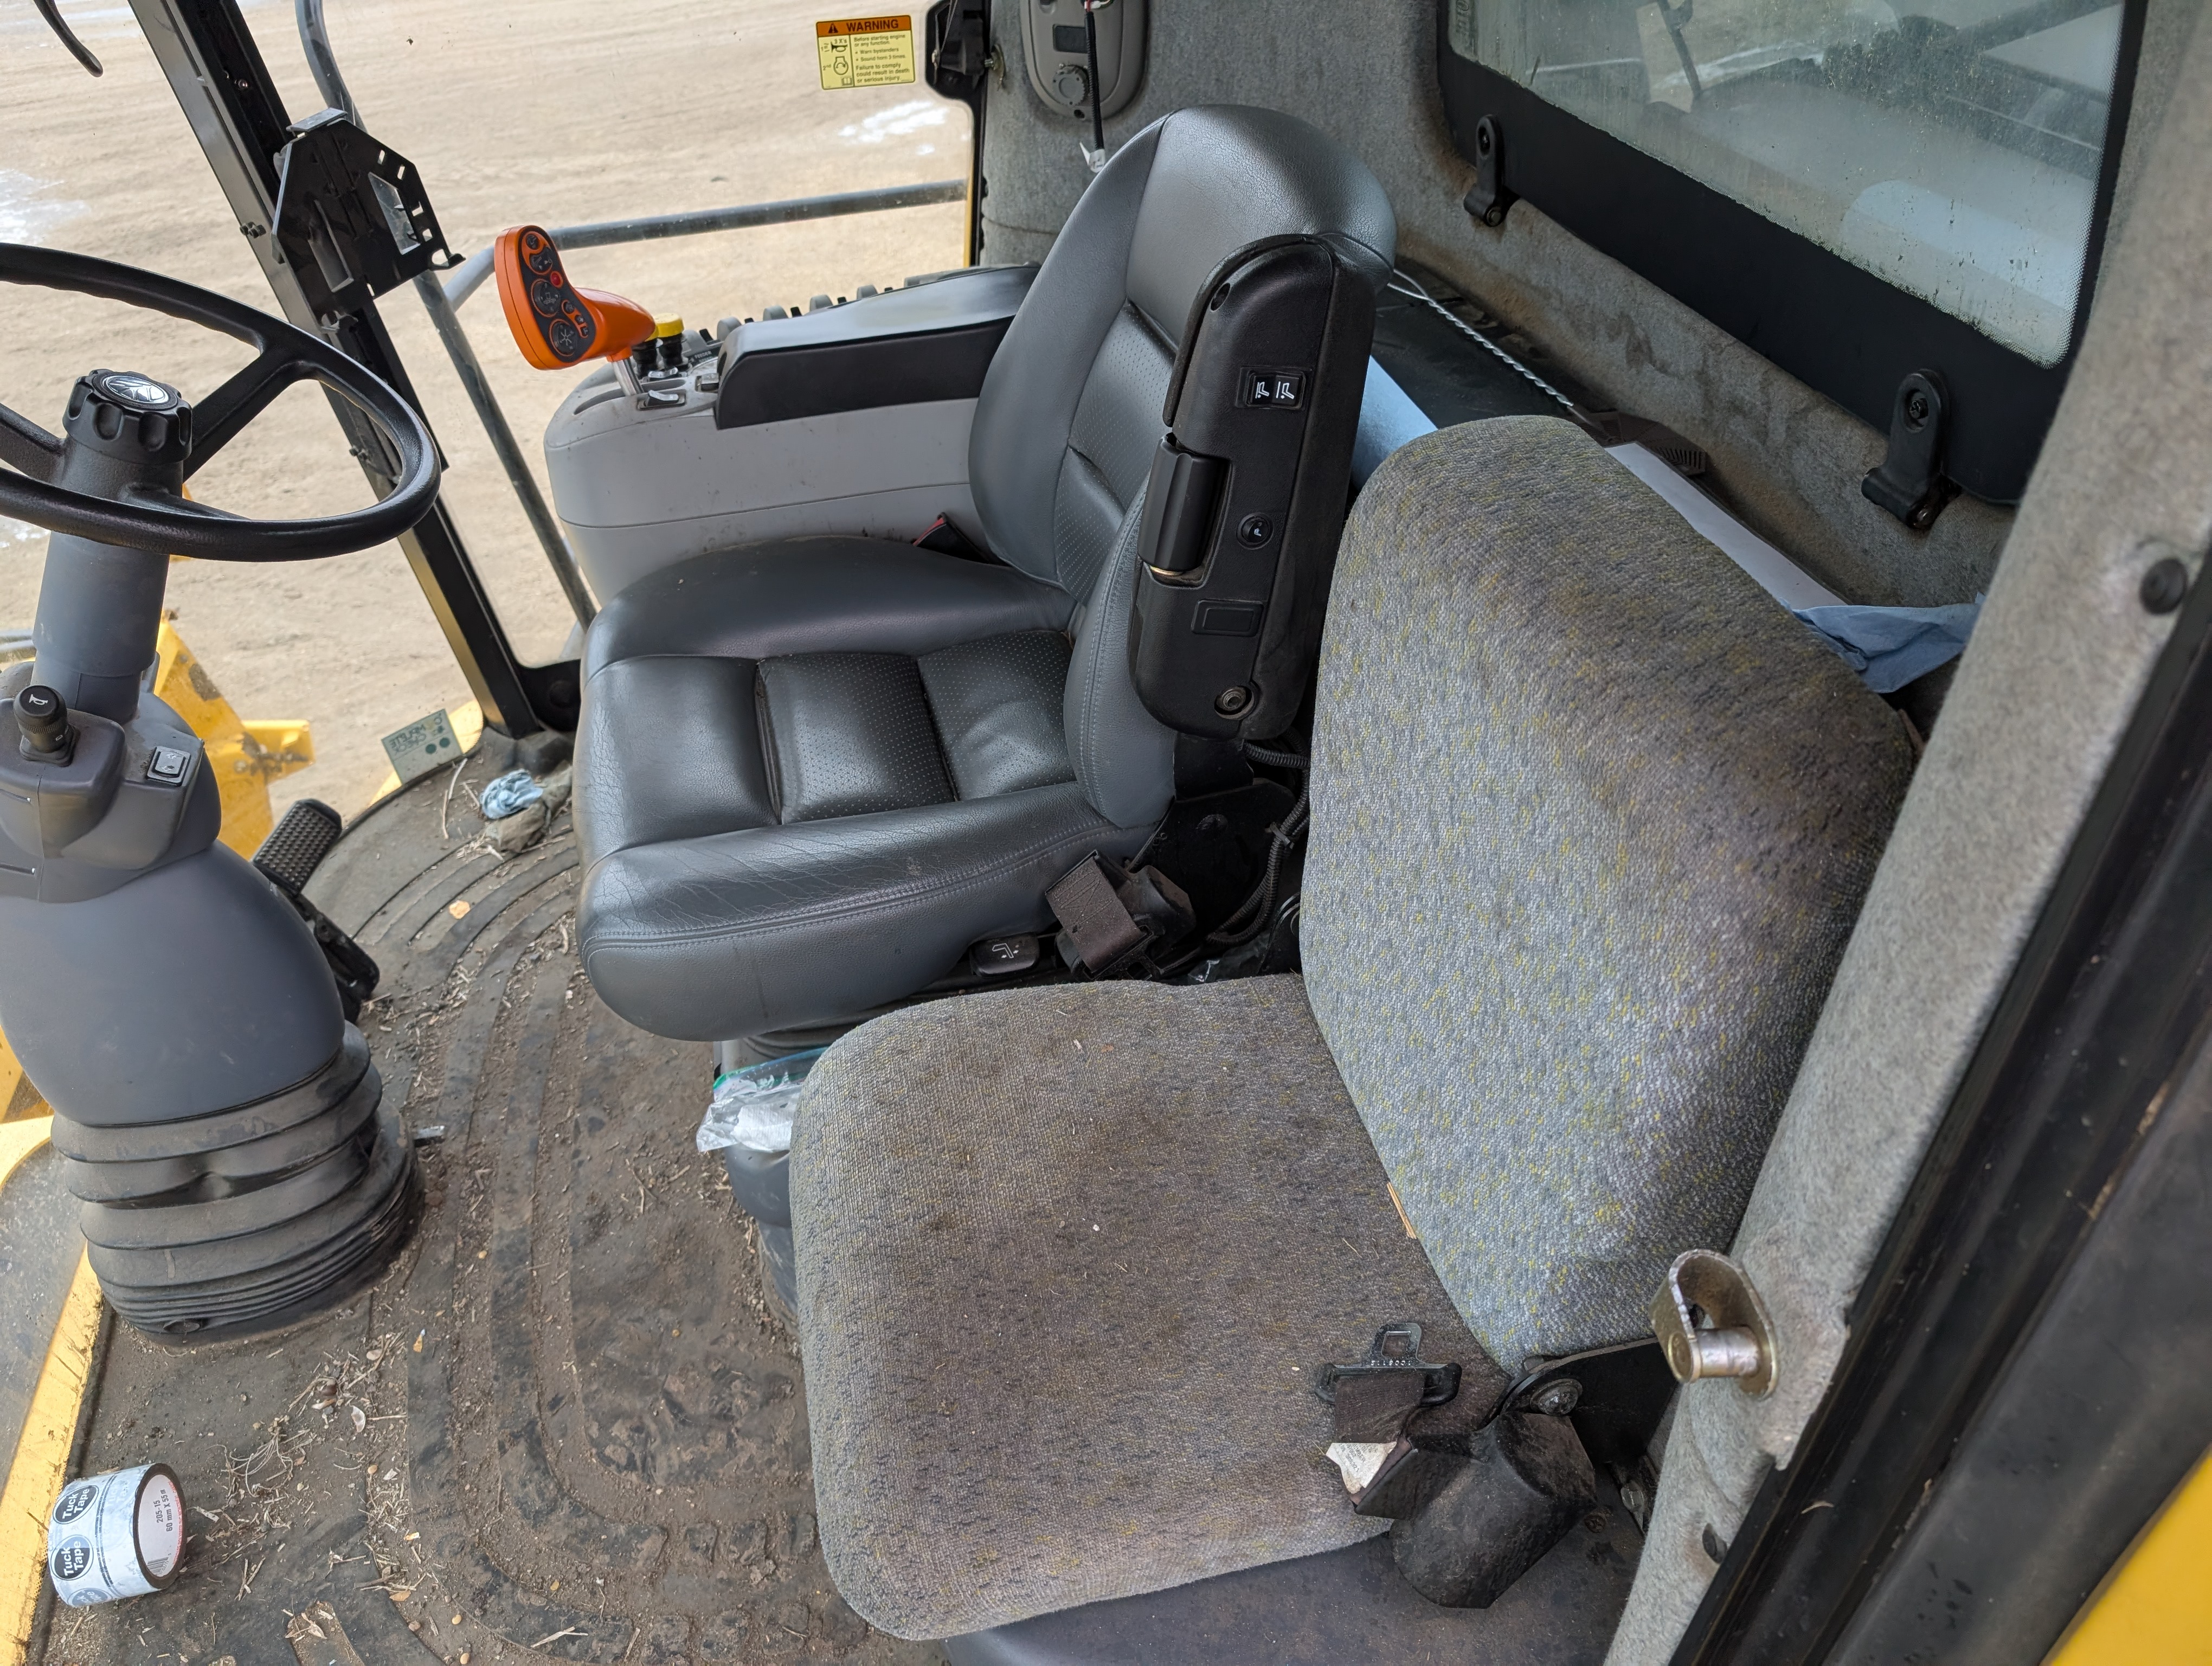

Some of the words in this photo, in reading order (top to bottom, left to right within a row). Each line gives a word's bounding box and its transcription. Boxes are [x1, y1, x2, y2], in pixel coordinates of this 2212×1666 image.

[846, 19, 898, 31] WARNING
[62, 1492, 79, 1519] Tuck
[74, 1488, 90, 1515] Tape
[153, 1500, 164, 1523] 205-15
[166, 1509, 172, 1521] mm
[166, 1522, 173, 1532] 60
[61, 1546, 74, 1577] Tuck
[73, 1540, 85, 1571] Tape
